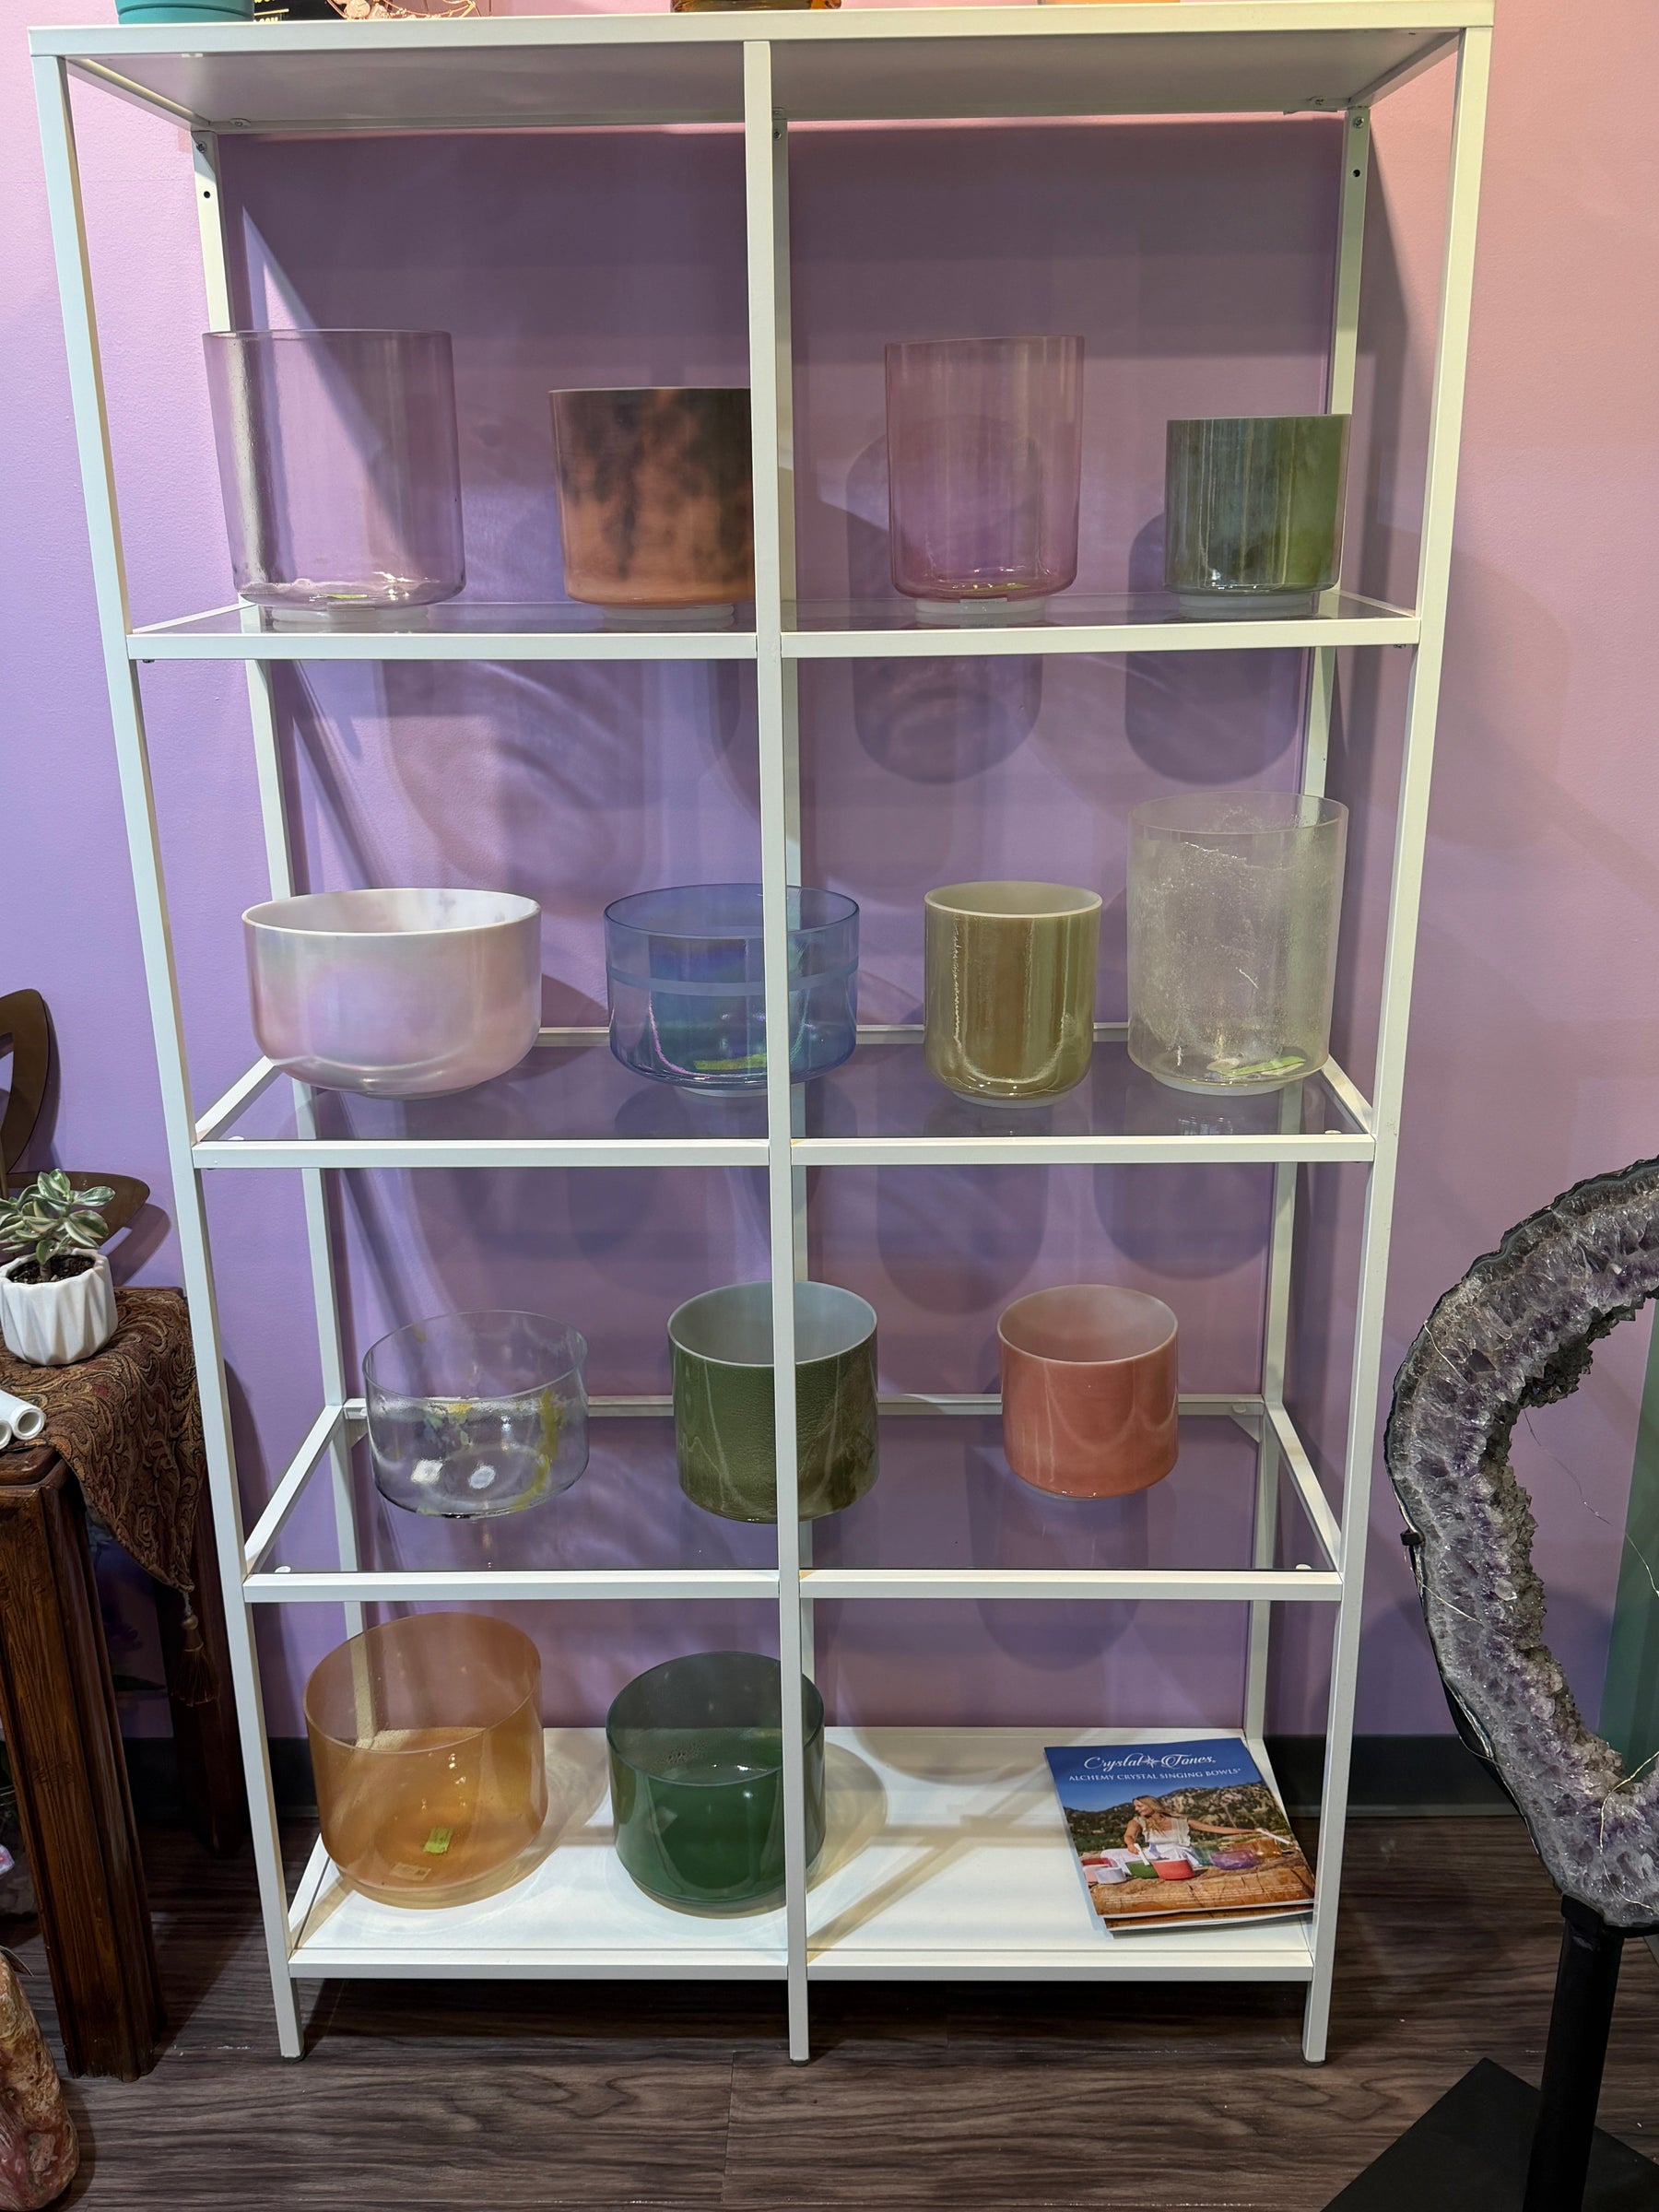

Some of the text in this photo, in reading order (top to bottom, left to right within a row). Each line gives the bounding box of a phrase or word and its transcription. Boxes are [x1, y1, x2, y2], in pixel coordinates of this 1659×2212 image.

[1084, 1752, 1145, 1772] Crystal
[1068, 1773, 1114, 1782] ALCHEMY
[1116, 1772, 1159, 1781] CRYSTAL
[1159, 1771, 1203, 1780] SINGING
